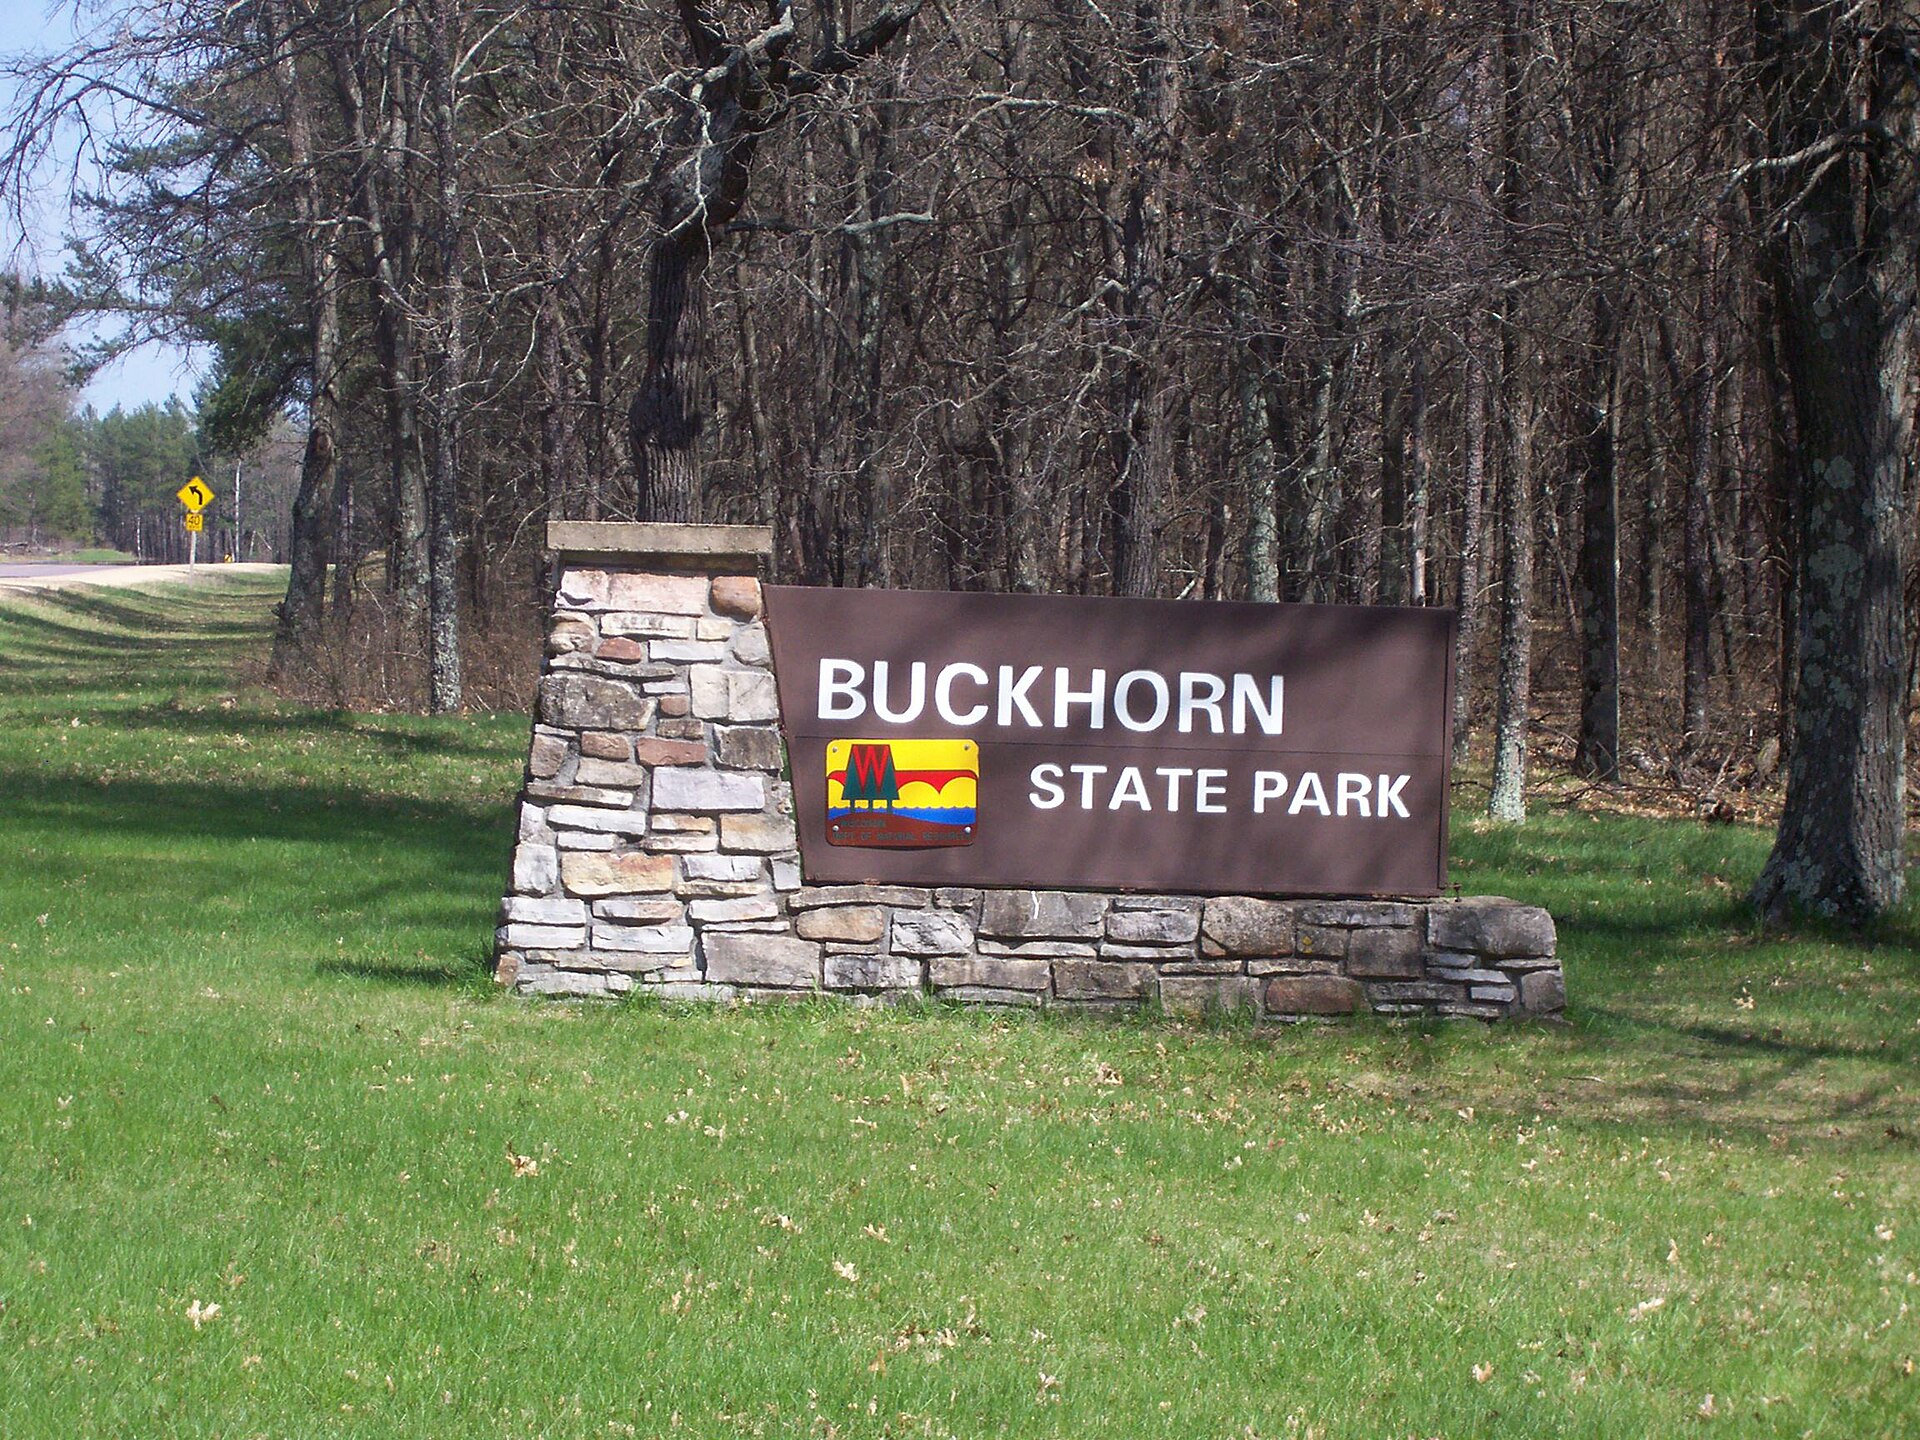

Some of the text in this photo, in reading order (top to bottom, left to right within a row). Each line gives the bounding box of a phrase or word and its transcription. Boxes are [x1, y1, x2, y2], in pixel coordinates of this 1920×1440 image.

[188, 515, 200, 525] 40
[817, 657, 1284, 735] BUCKHORN
[1028, 762, 1411, 818] STATE PARK
